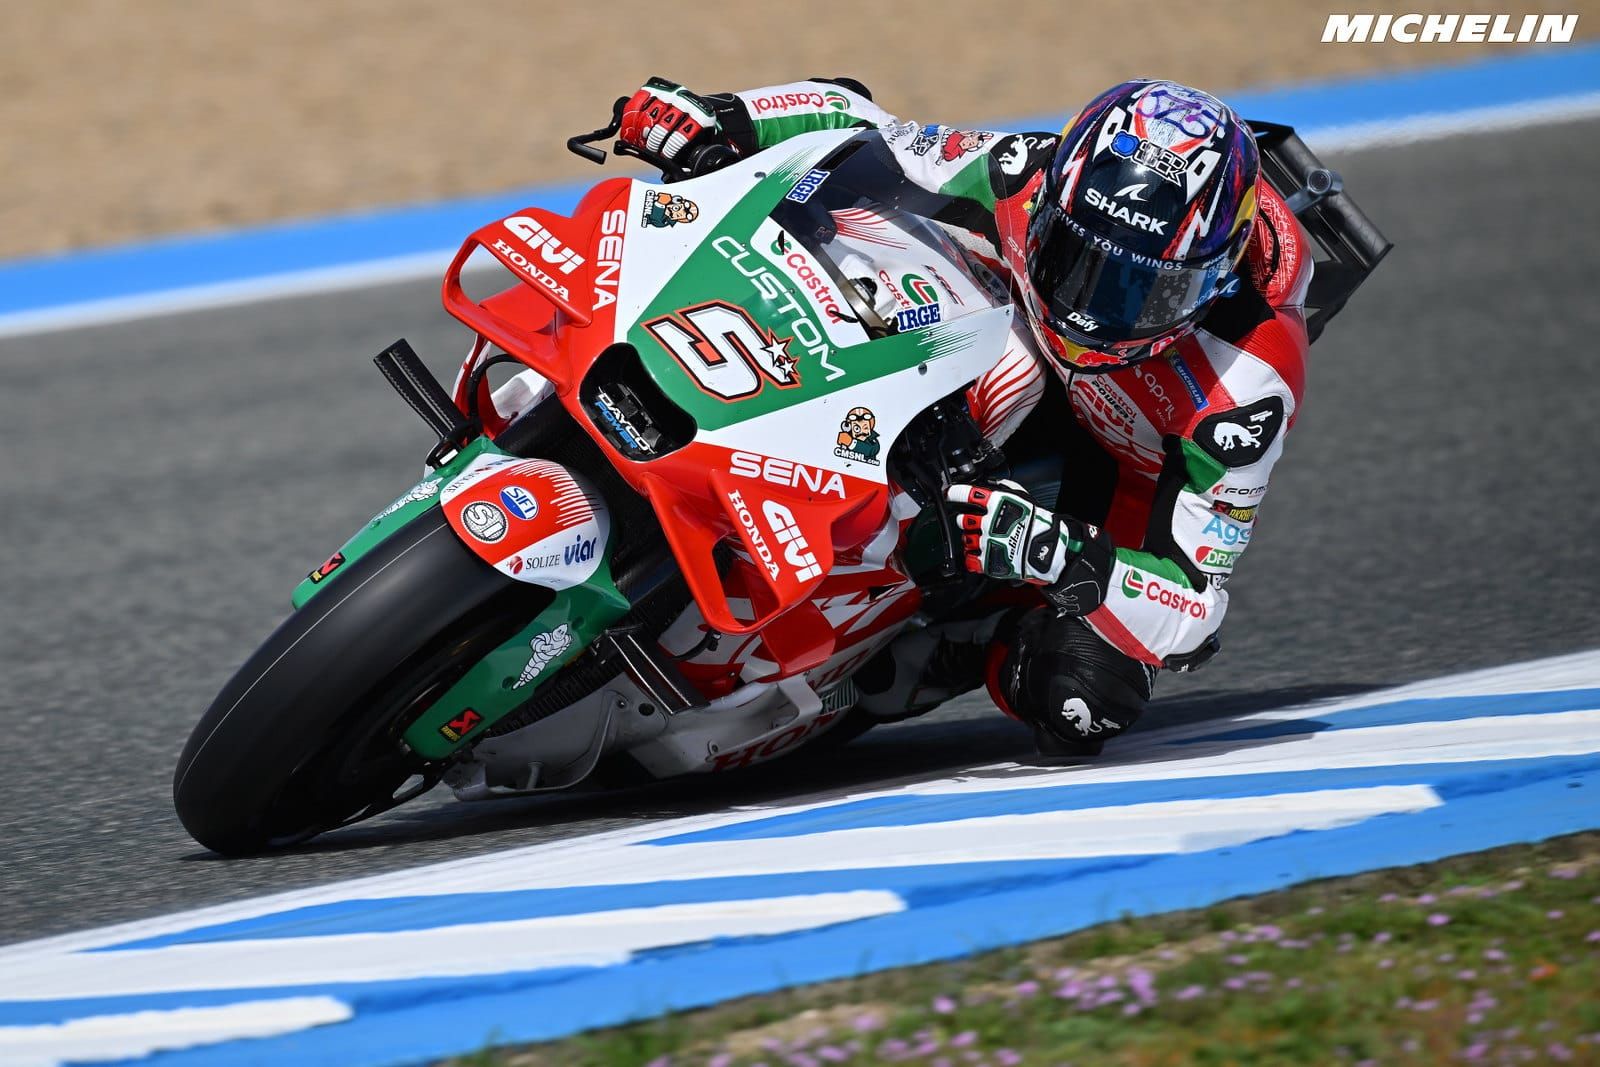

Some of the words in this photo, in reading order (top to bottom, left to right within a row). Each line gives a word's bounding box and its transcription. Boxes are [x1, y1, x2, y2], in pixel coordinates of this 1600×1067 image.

[751, 91, 825, 114] Castrol
[787, 169, 830, 202] IRGE
[1084, 187, 1169, 236] SHARK
[503, 216, 586, 275] GIVI
[592, 209, 626, 311] SENA
[1055, 207, 1087, 238] GIVES
[1093, 236, 1124, 257] YOU
[1131, 252, 1184, 272] WINGS
[491, 238, 570, 302] HONDA
[878, 270, 912, 308] Cast
[711, 235, 847, 382] CUSTOM
[897, 303, 941, 331] IRGE
[1066, 311, 1100, 333] Dafy
[642, 301, 800, 402] 5
[1073, 380, 1134, 436] GIVI
[1096, 374, 1138, 419] Castrol
[1175, 364, 1203, 405] MICHELIN
[594, 400, 638, 448] POWER
[598, 392, 651, 451] DAYCO
[729, 451, 846, 499] SENA
[506, 486, 536, 515] SIFI
[564, 534, 597, 566] viar
[727, 489, 780, 581] HONDA
[762, 499, 823, 583] GIVI
[525, 554, 561, 570] SOLIZE
[1146, 581, 1206, 620] Castrol
